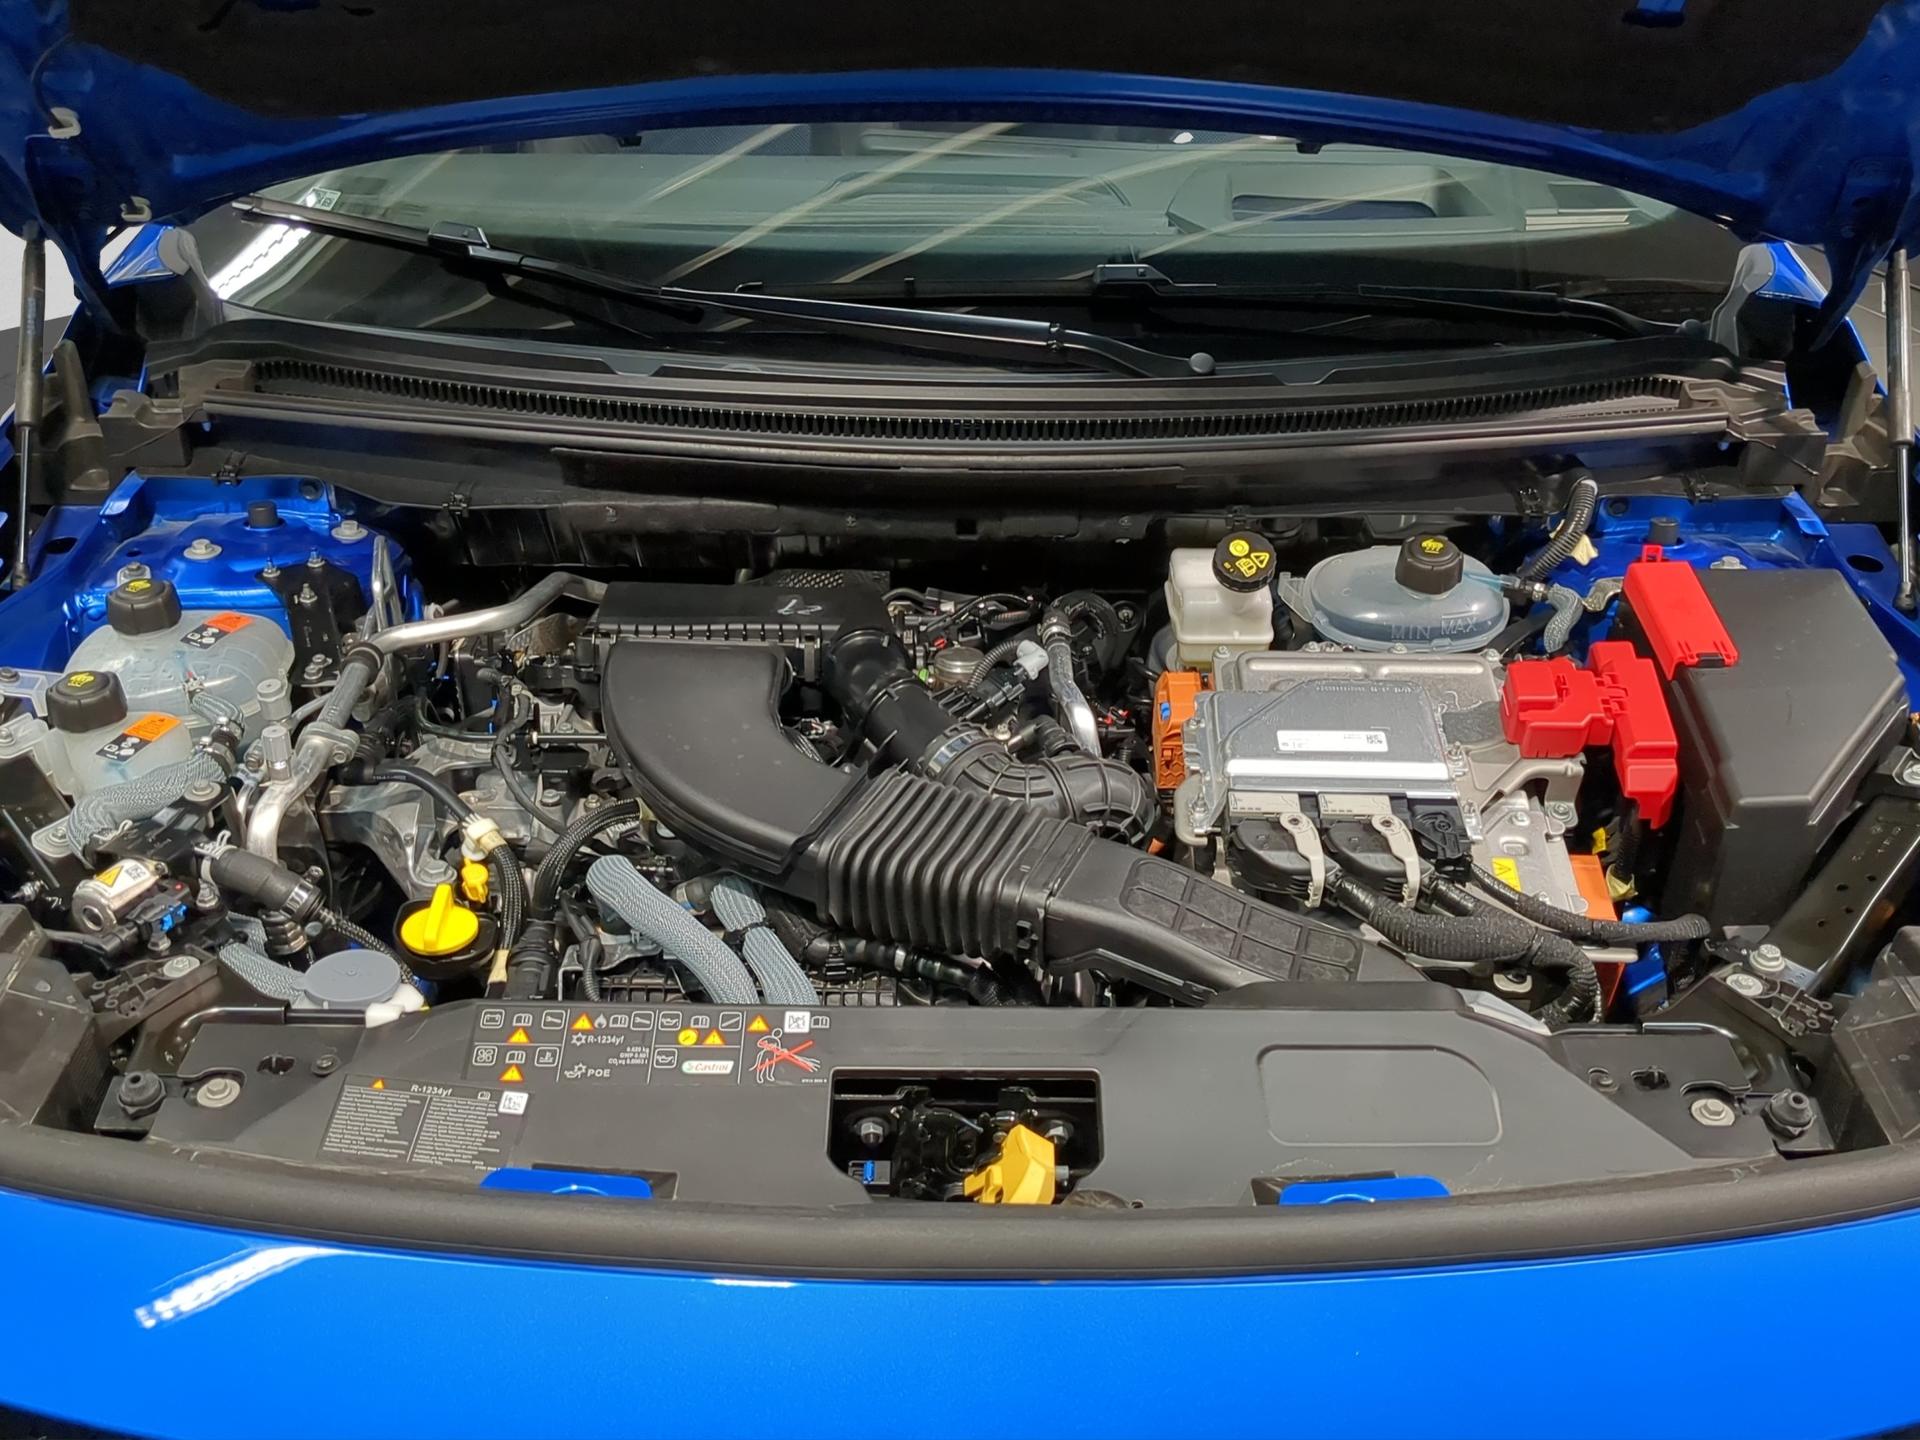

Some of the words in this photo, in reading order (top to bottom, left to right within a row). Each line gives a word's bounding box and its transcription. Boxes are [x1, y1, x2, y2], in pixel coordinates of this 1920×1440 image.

[1391, 624, 1430, 639] MIN
[1441, 618, 1477, 635] MAX
[587, 1034, 625, 1046] R-1234yf
[587, 1068, 611, 1078] POE
[695, 1062, 729, 1072] Castrol
[410, 1084, 453, 1097] R-1234yf
